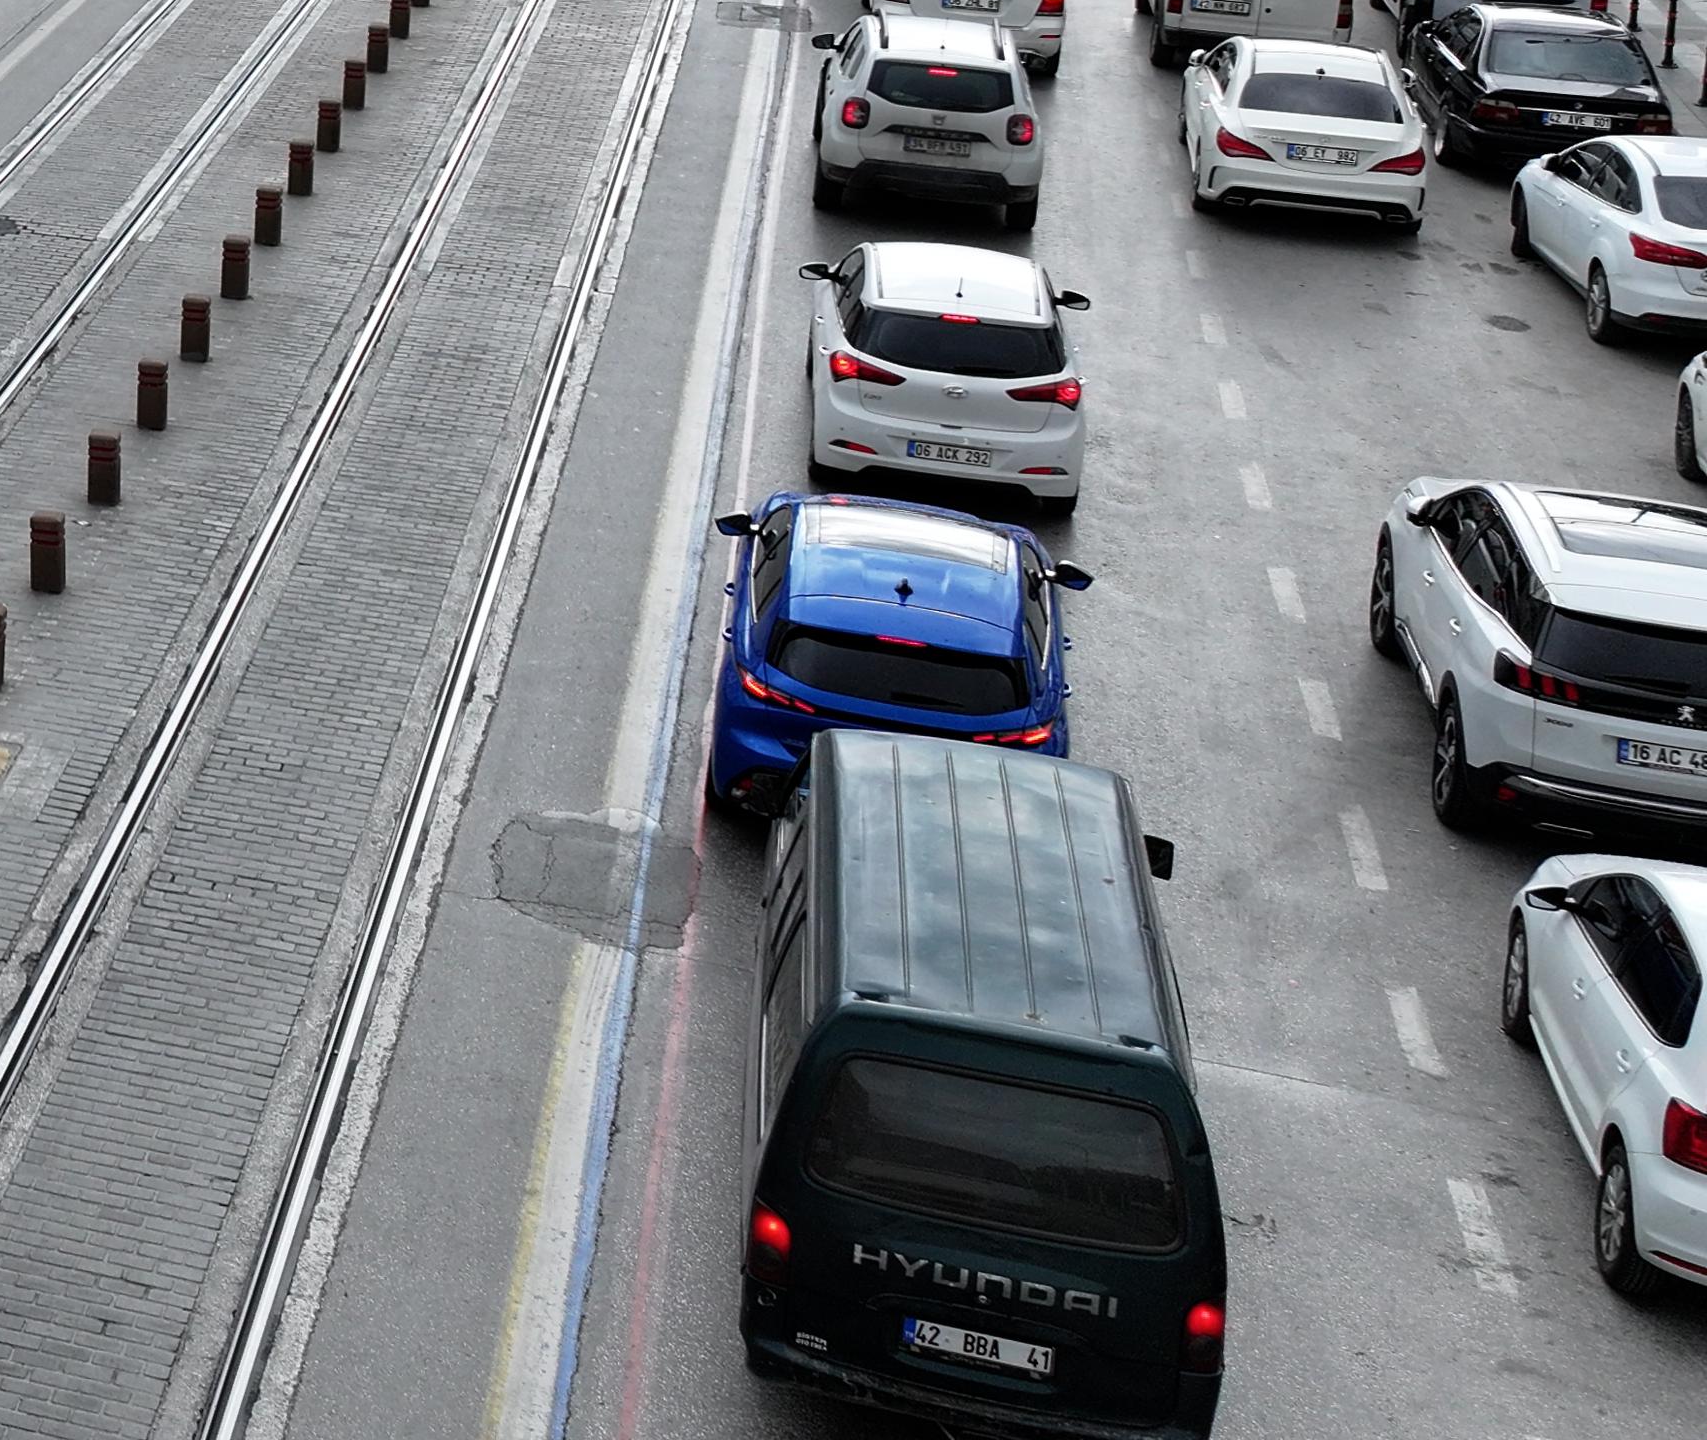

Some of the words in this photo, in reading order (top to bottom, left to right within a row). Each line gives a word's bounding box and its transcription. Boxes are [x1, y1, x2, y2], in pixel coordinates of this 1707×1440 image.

[1294, 146, 1307, 157] 06
[915, 443, 931, 457] 06
[936, 446, 960, 461] ACK
[964, 450, 989, 465] 292
[1631, 743, 1651, 760] 16
[1656, 747, 1682, 766] AC
[853, 1243, 1118, 1318] HYUNDAI
[915, 1322, 941, 1347] 42
[963, 1333, 1000, 1360] BBA
[1026, 1347, 1051, 1370] 41
